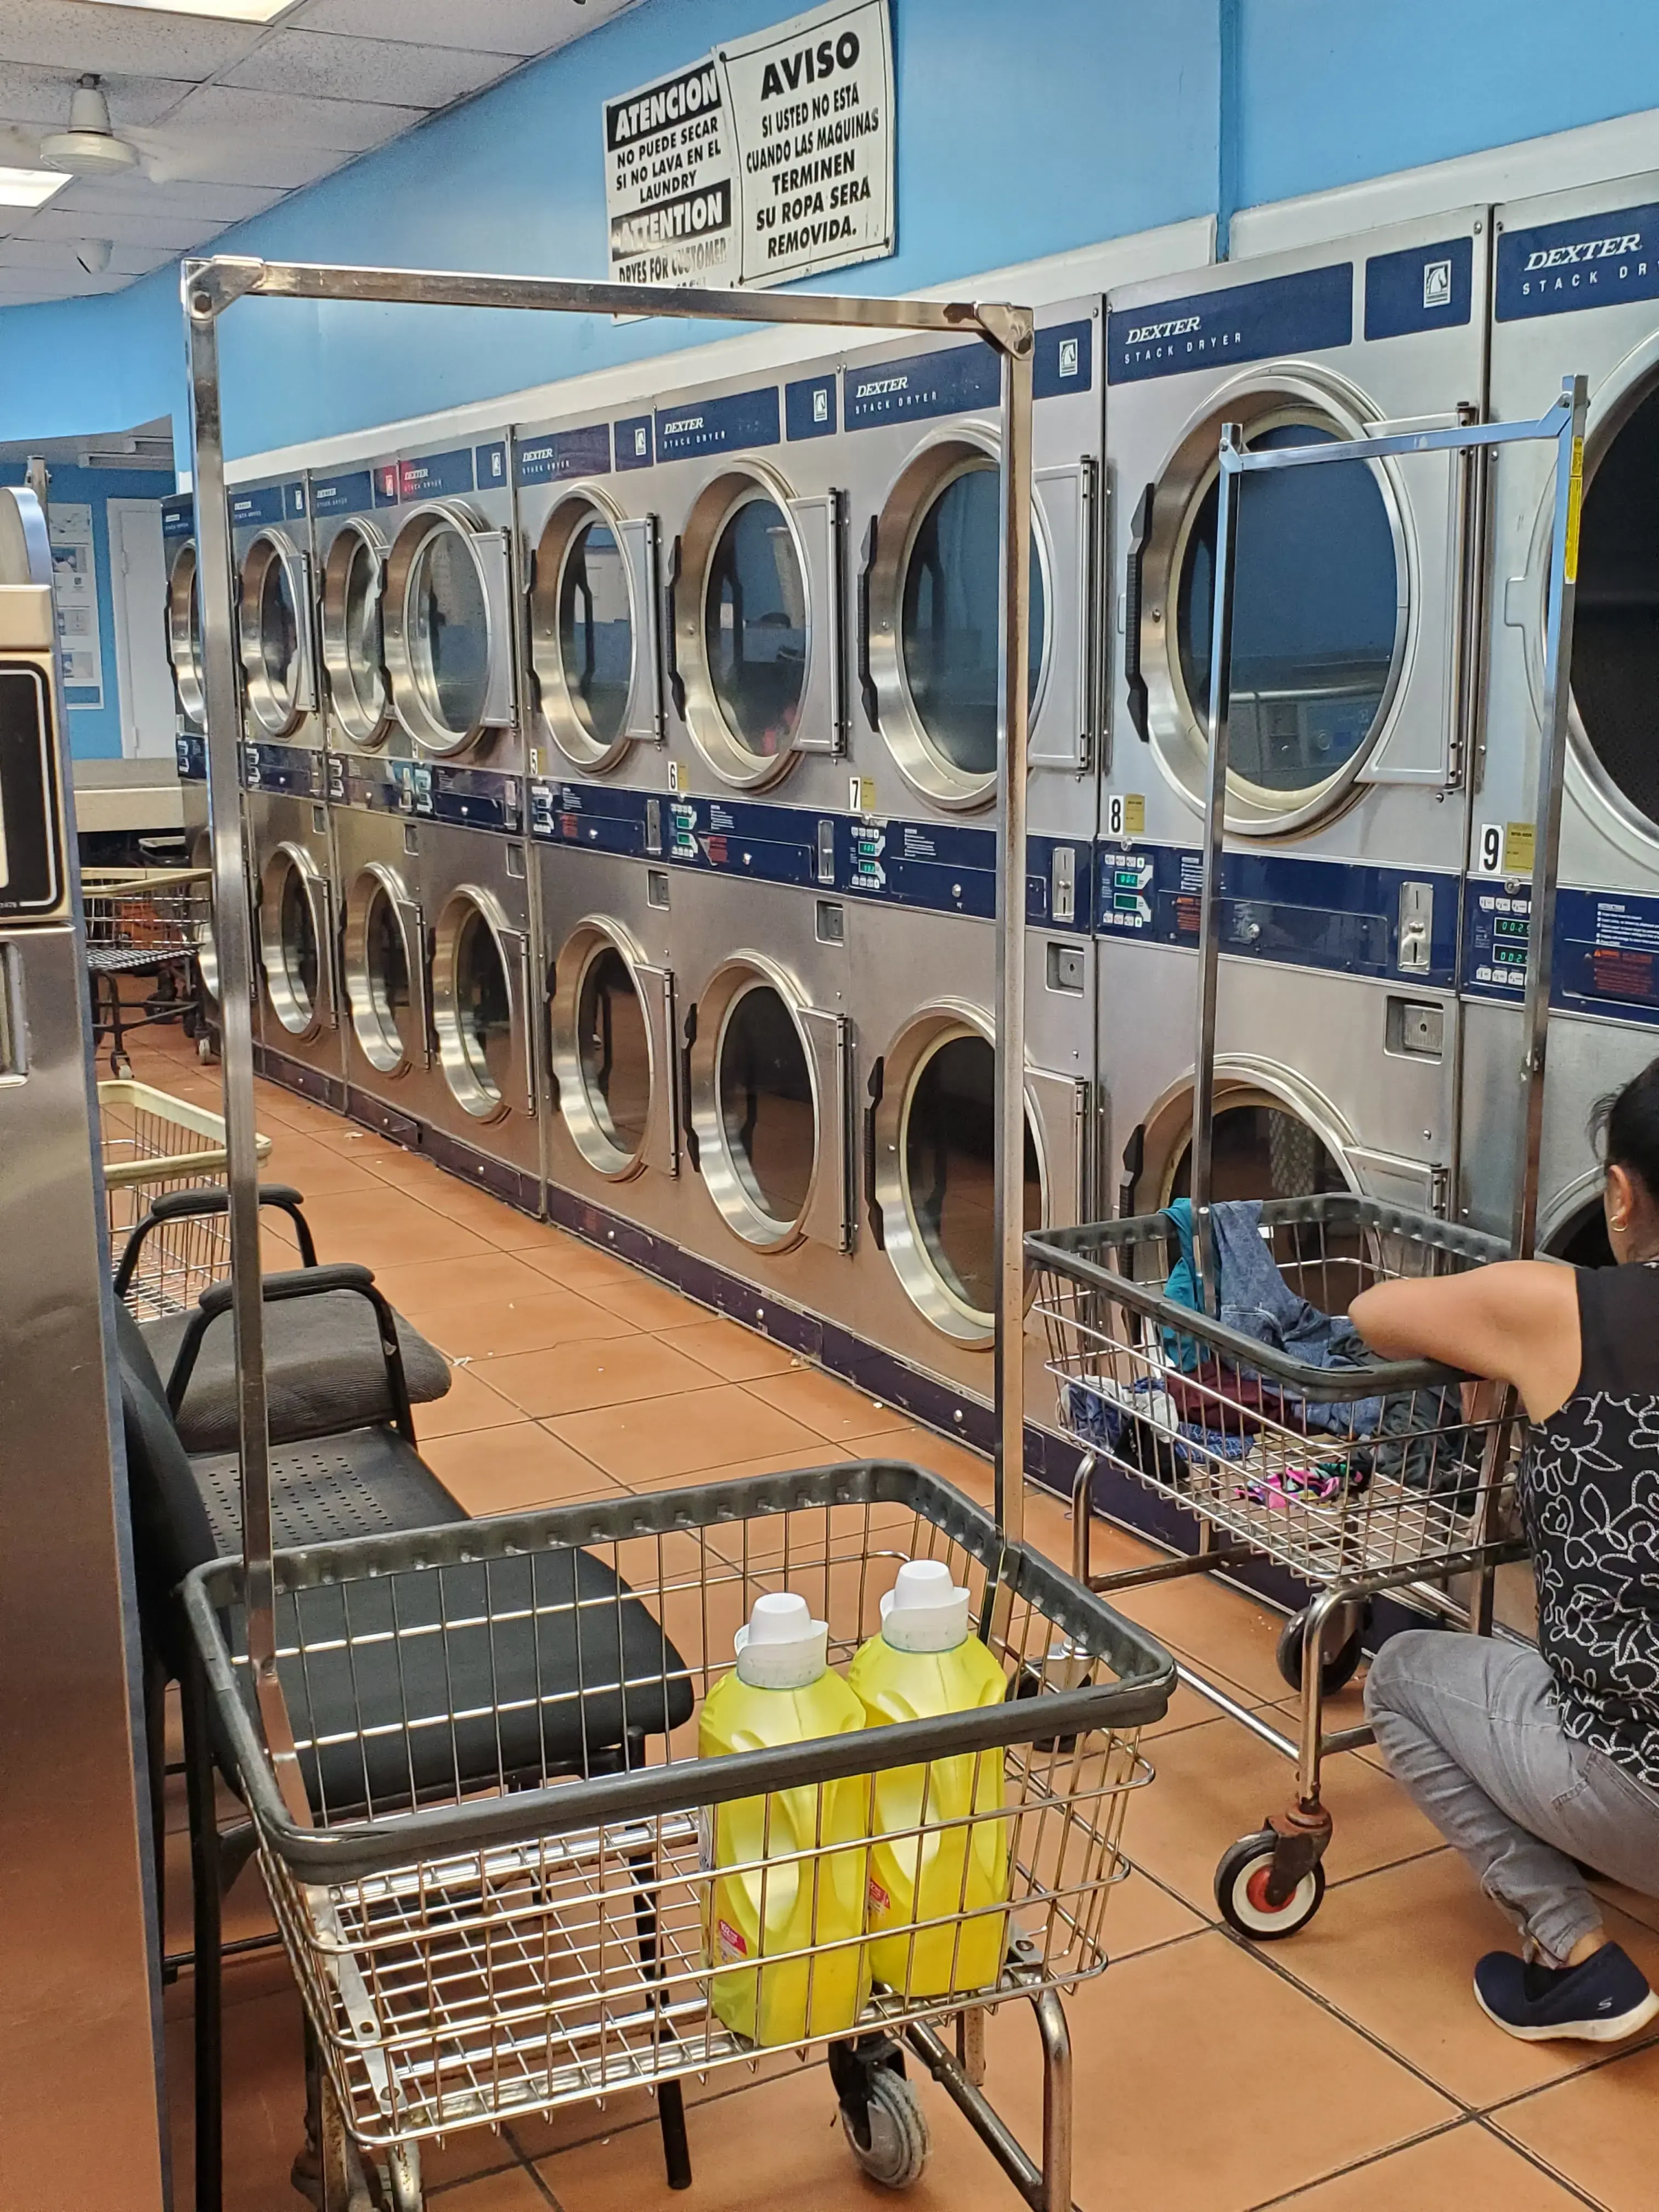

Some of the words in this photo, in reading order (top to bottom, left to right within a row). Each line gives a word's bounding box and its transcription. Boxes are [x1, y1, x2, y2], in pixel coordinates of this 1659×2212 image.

[760, 31, 860, 101] AVISO
[615, 67, 718, 142] ATENCION
[761, 114, 772, 138] SI
[776, 102, 809, 133] USTED
[812, 93, 830, 121] NO
[617, 149, 635, 169] NO
[639, 132, 676, 161] PUEDE
[681, 116, 719, 145] SECAR
[746, 139, 791, 174] CUANDO
[795, 131, 813, 159] LAS
[817, 106, 879, 151] MAQUINAS
[616, 173, 627, 191] SI
[631, 166, 648, 186] NO
[652, 153, 684, 178] LAVA
[687, 145, 703, 166] EN
[708, 139, 721, 159] EL
[772, 149, 855, 196] TERMINEN
[640, 170, 697, 204] LAUNDRY
[619, 191, 723, 254] ATTENTION
[756, 205, 776, 232] SU
[782, 191, 825, 224] ROPA
[768, 215, 857, 259] REMOVIDA.
[1523, 233, 1641, 272] DEXTER
[650, 254, 669, 283] FOR
[1522, 270, 1598, 296] STACK
[1620, 259, 1659, 279] DR
[1125, 315, 1201, 345] DEXTER
[1125, 345, 1174, 365] STACK
[1187, 332, 1241, 353] DRYER
[855, 376, 909, 398] DEXTER
[664, 417, 704, 435] DEXTER
[855, 399, 890, 415] STACK
[670, 764, 676, 790] 6
[852, 780, 859, 809] 7
[1111, 798, 1121, 833] 8
[1483, 828, 1500, 871] 9
